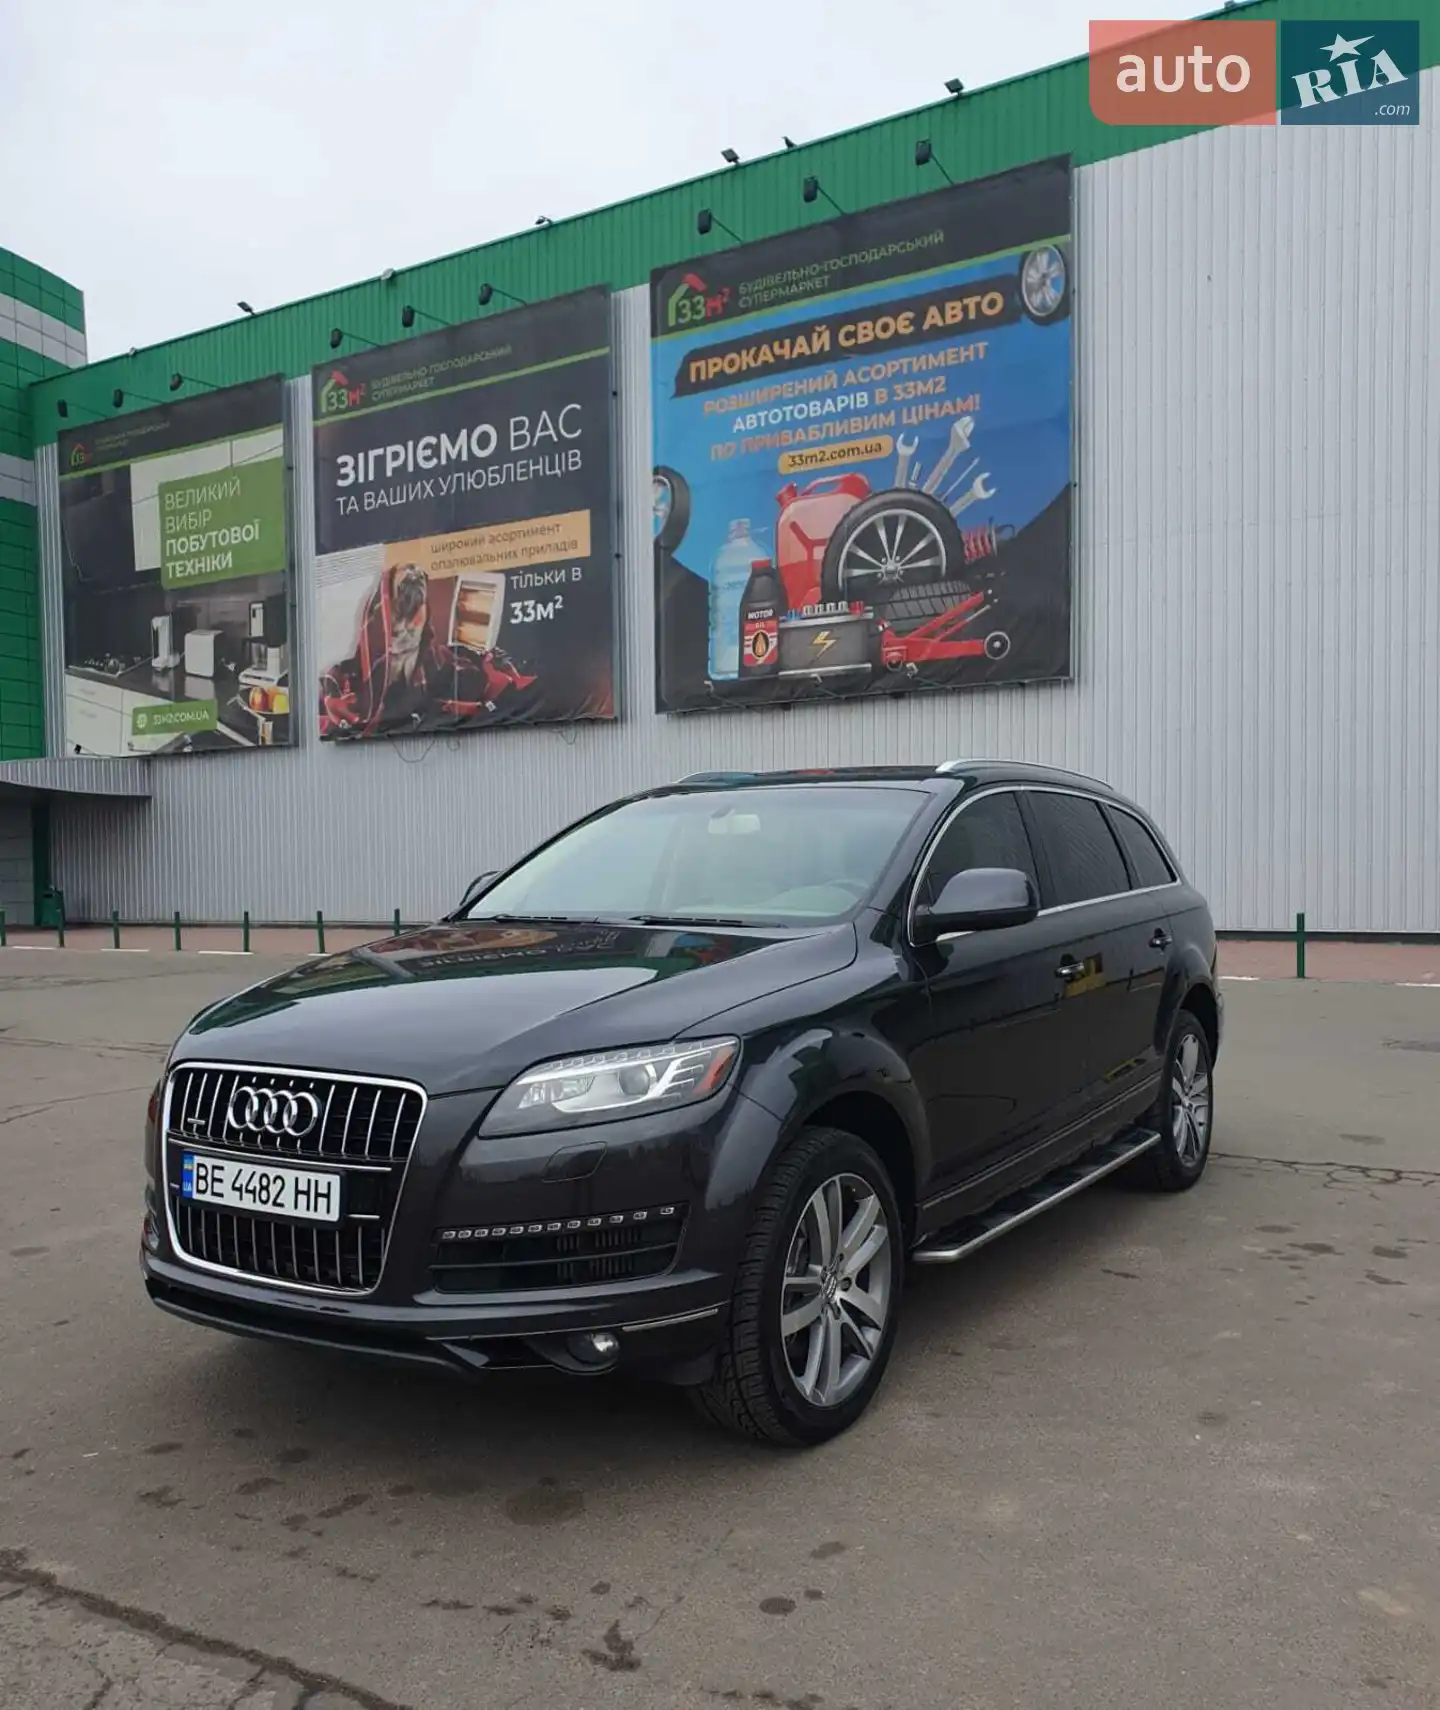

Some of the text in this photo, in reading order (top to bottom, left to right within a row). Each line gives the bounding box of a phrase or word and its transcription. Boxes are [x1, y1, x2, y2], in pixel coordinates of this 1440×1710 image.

[738, 275, 830, 308] СУПЕРМАРКЕТ
[690, 291, 1004, 383] ПРОКАЧАЙ СВОЄ АВТО
[703, 341, 989, 415] РОЗШИРЕНИЙ АСОРТИМЕНТ
[711, 394, 981, 461] ПО ПРИВАБЛИВИМ ЦІНАМ!
[732, 391, 869, 433] АВТОТОВАРІВ
[336, 403, 583, 488] ЗІГРІЄМО ВАС
[787, 441, 883, 467] 33m2.com.ua
[164, 475, 242, 510] ВЕЛИКИЙ
[337, 448, 582, 516] ТА ВАШИХ УЛЮБЛЕНЦІВ
[164, 508, 212, 534] ВИБІР
[165, 518, 261, 557] ПОБУТОВОЇ
[488, 523, 562, 545] асортимент
[166, 551, 233, 580] ТЕХНІКИ
[431, 536, 578, 571] опалювальних приладів
[183, 1180, 192, 1192] UA
[195, 1162, 332, 1214] BE 4482 HH
